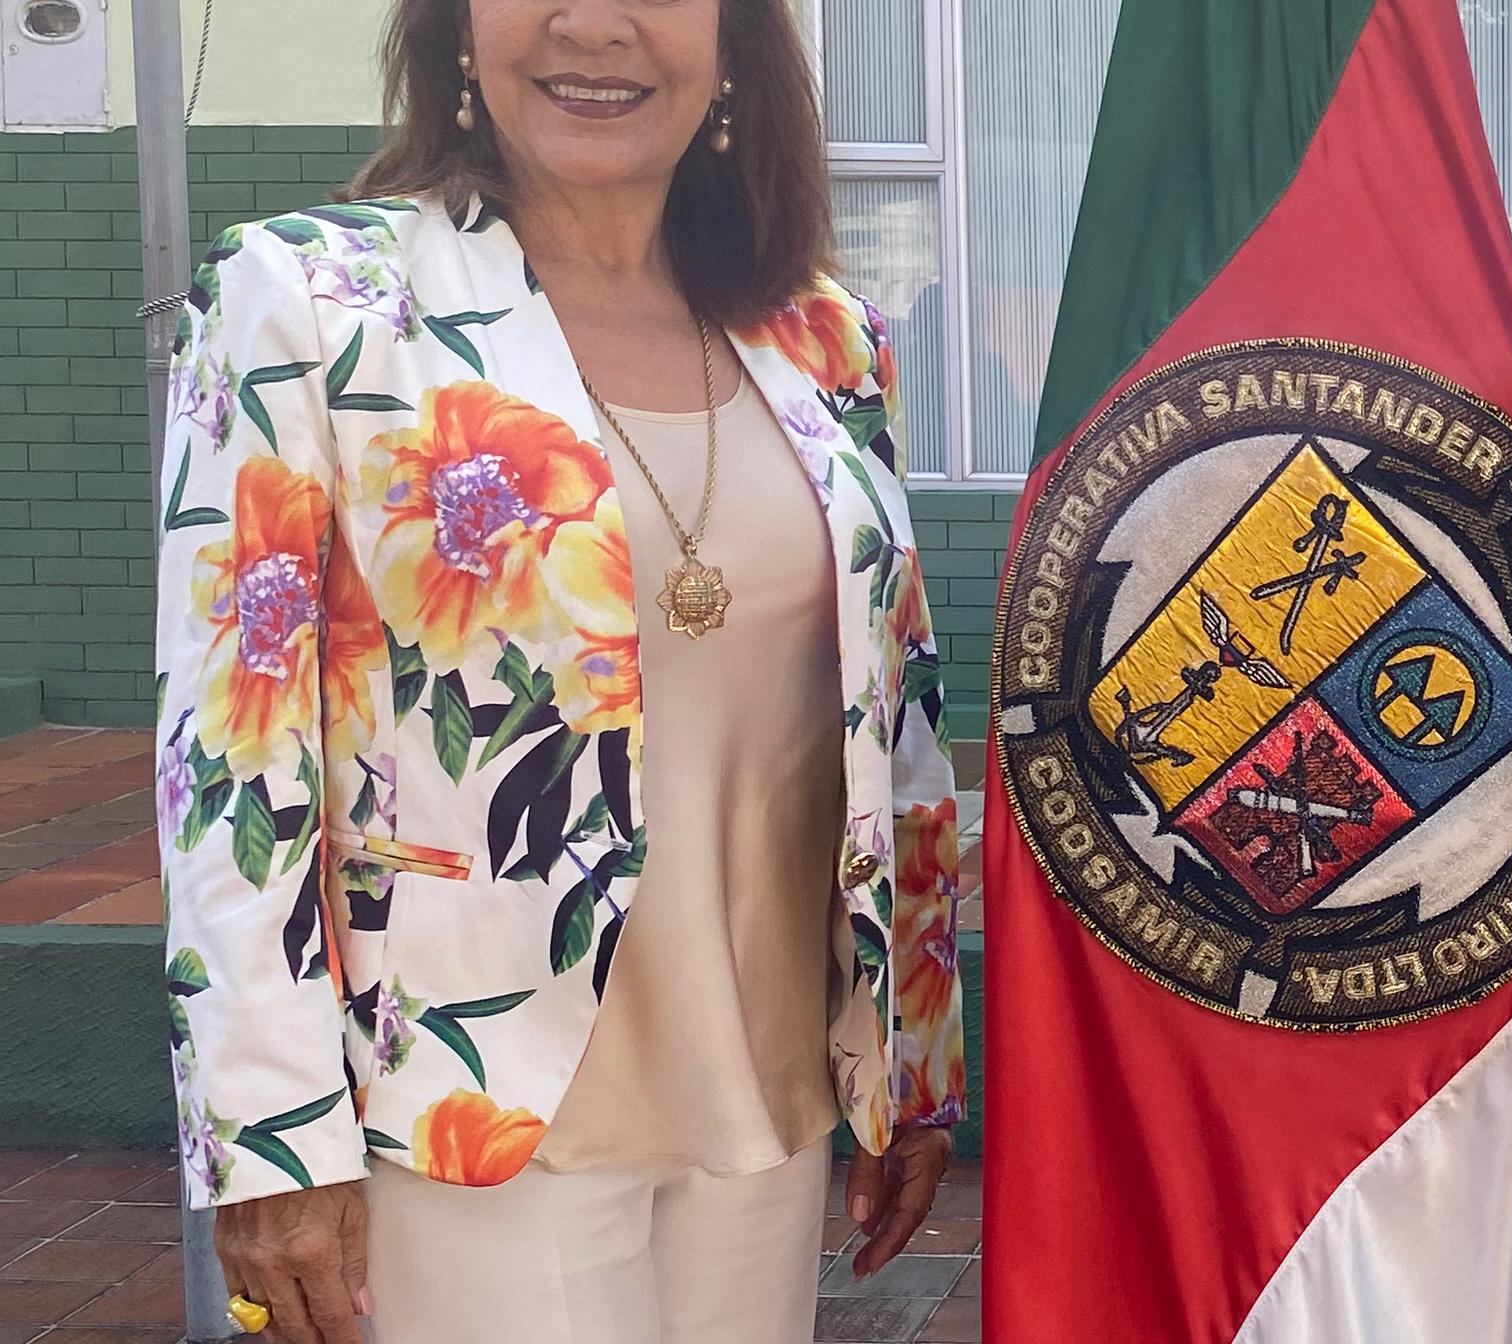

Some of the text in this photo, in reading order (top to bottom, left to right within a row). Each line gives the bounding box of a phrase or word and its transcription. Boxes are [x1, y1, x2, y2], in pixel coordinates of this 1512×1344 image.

[1020, 370, 1504, 689] COOPERATIVA SANTANDER
[1028, 755, 1225, 984] COOSAMIR
[1290, 951, 1427, 1004] LTDA.
